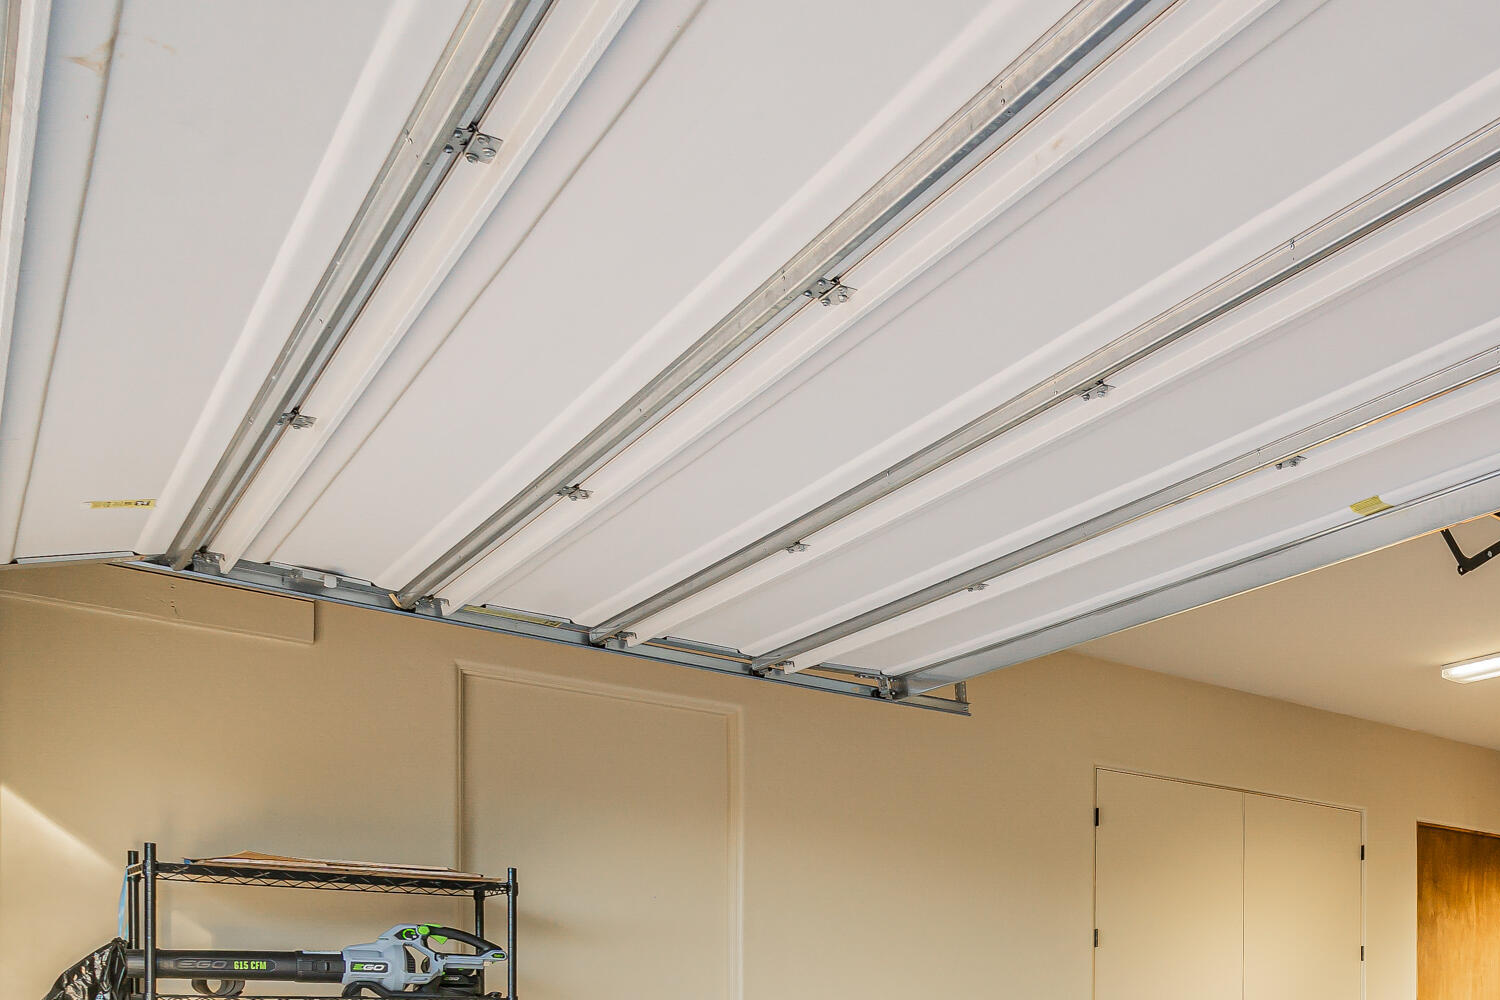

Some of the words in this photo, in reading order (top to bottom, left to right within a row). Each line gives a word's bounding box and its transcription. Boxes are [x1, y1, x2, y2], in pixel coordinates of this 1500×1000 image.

[233, 960, 249, 970] 615
[250, 960, 267, 970] CFM
[352, 963, 385, 972] EGO
